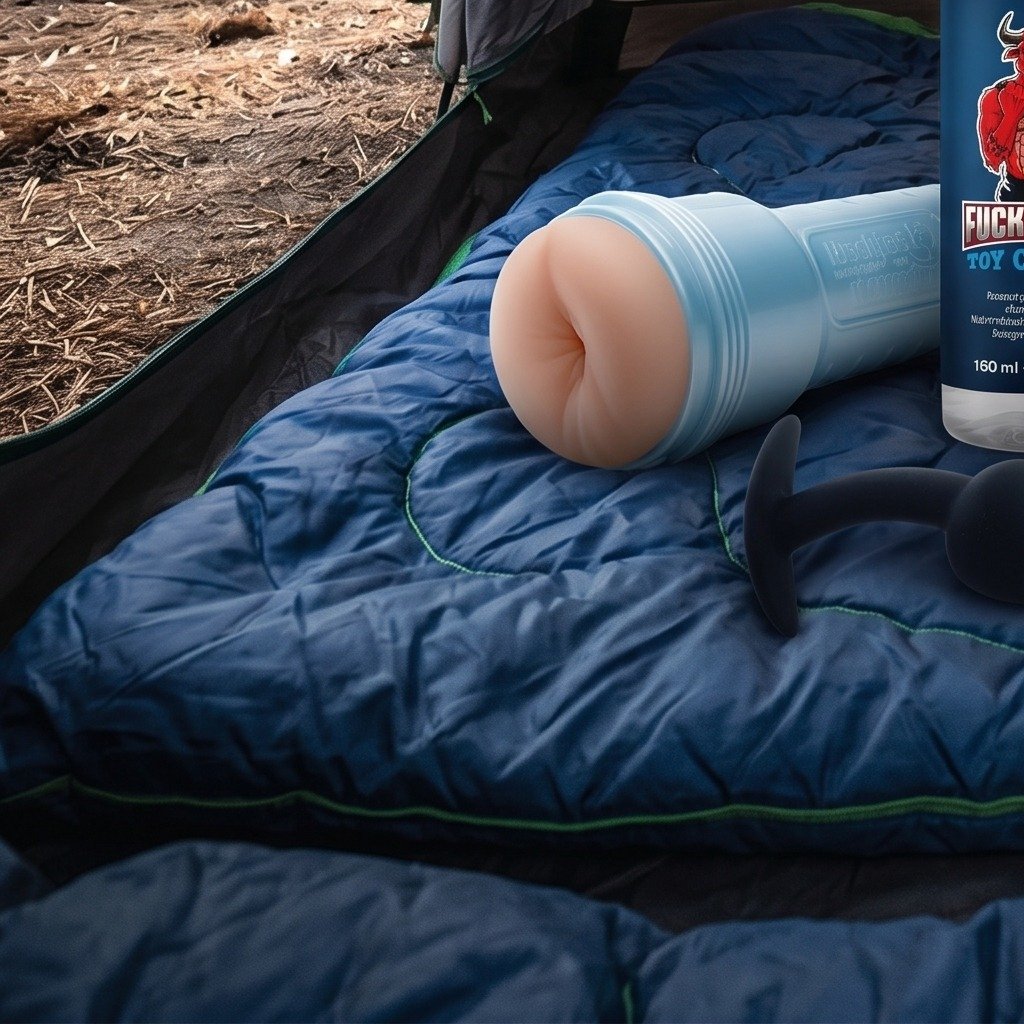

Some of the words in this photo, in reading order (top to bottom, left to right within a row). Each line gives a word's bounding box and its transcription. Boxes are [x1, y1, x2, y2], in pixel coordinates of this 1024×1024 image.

[965, 205, 1024, 243] FUCK
[966, 249, 1005, 270] TOY
[973, 359, 998, 373] 160
[1000, 360, 1018, 374] ml
